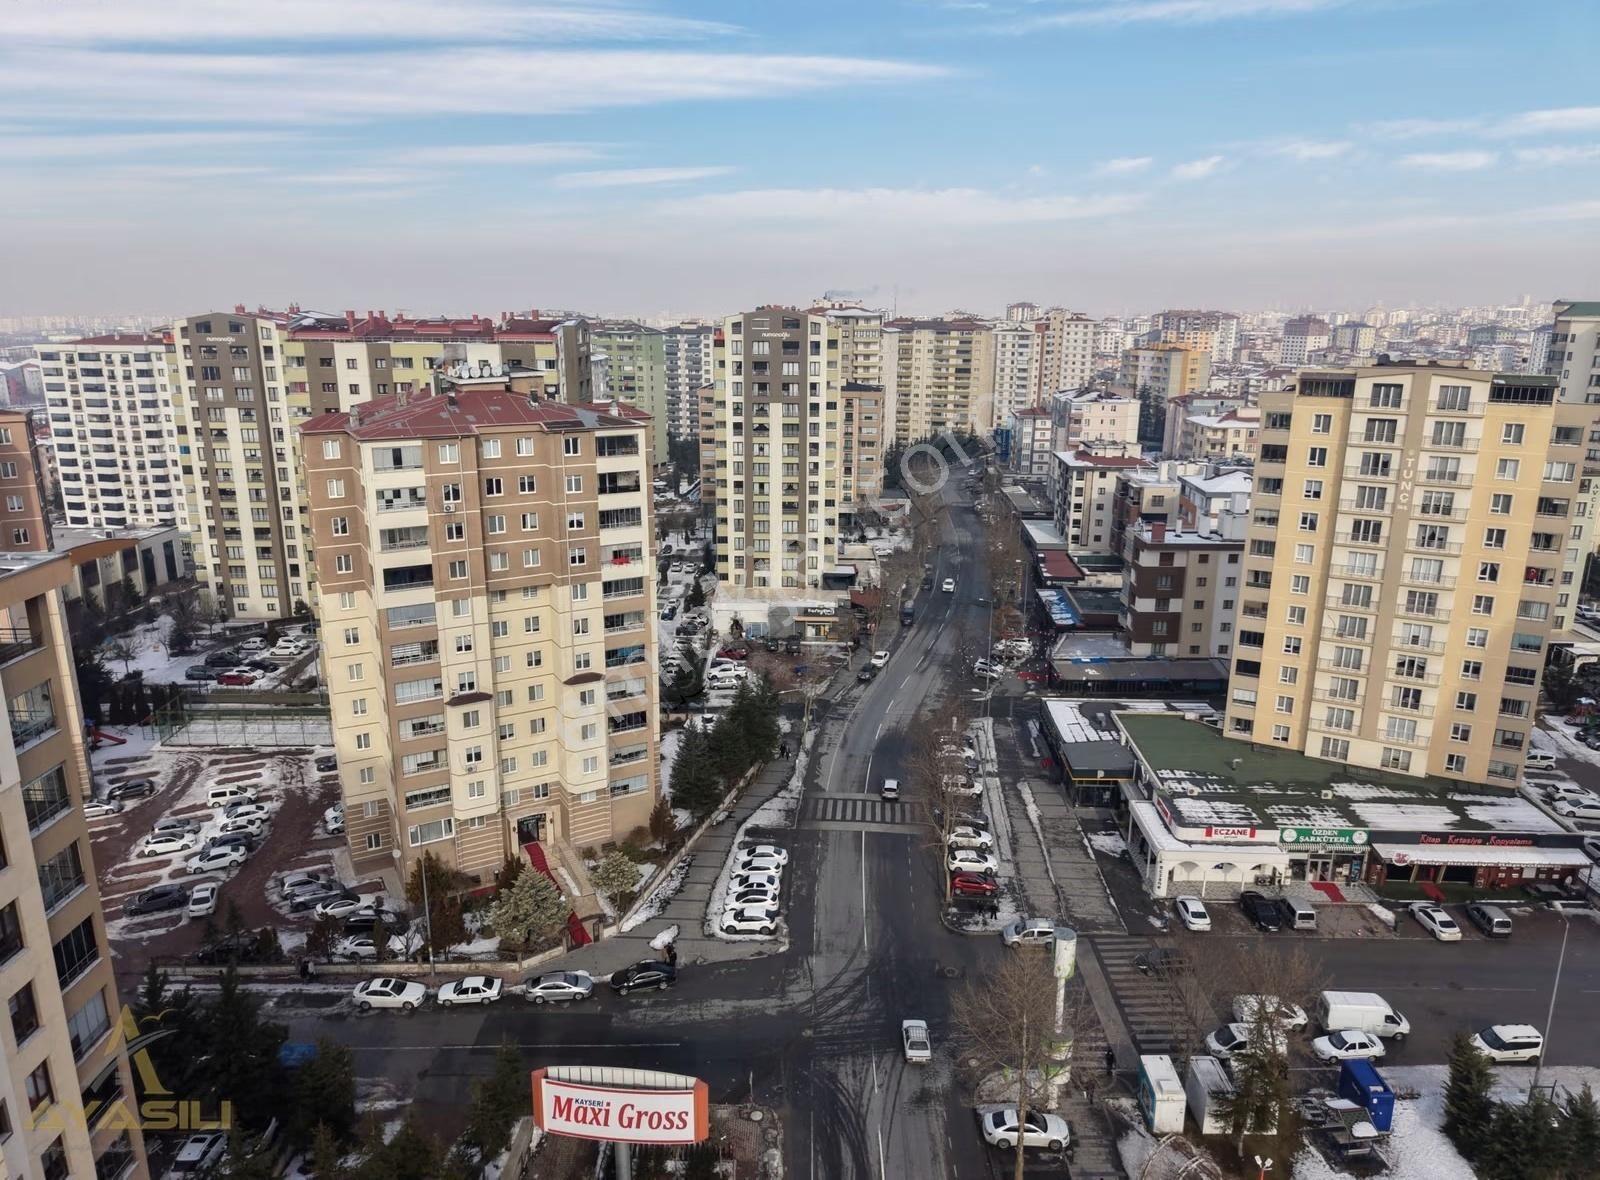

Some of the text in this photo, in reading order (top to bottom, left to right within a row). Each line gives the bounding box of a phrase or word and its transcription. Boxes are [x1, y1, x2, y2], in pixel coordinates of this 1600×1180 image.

[1213, 828, 1249, 836] ECZANE
[1311, 828, 1338, 836] ÖZDEN
[1299, 835, 1350, 843] ŞARKÜTERİ
[574, 1098, 604, 1108] KAYSERİ
[552, 1095, 689, 1130] Maxi Gross
